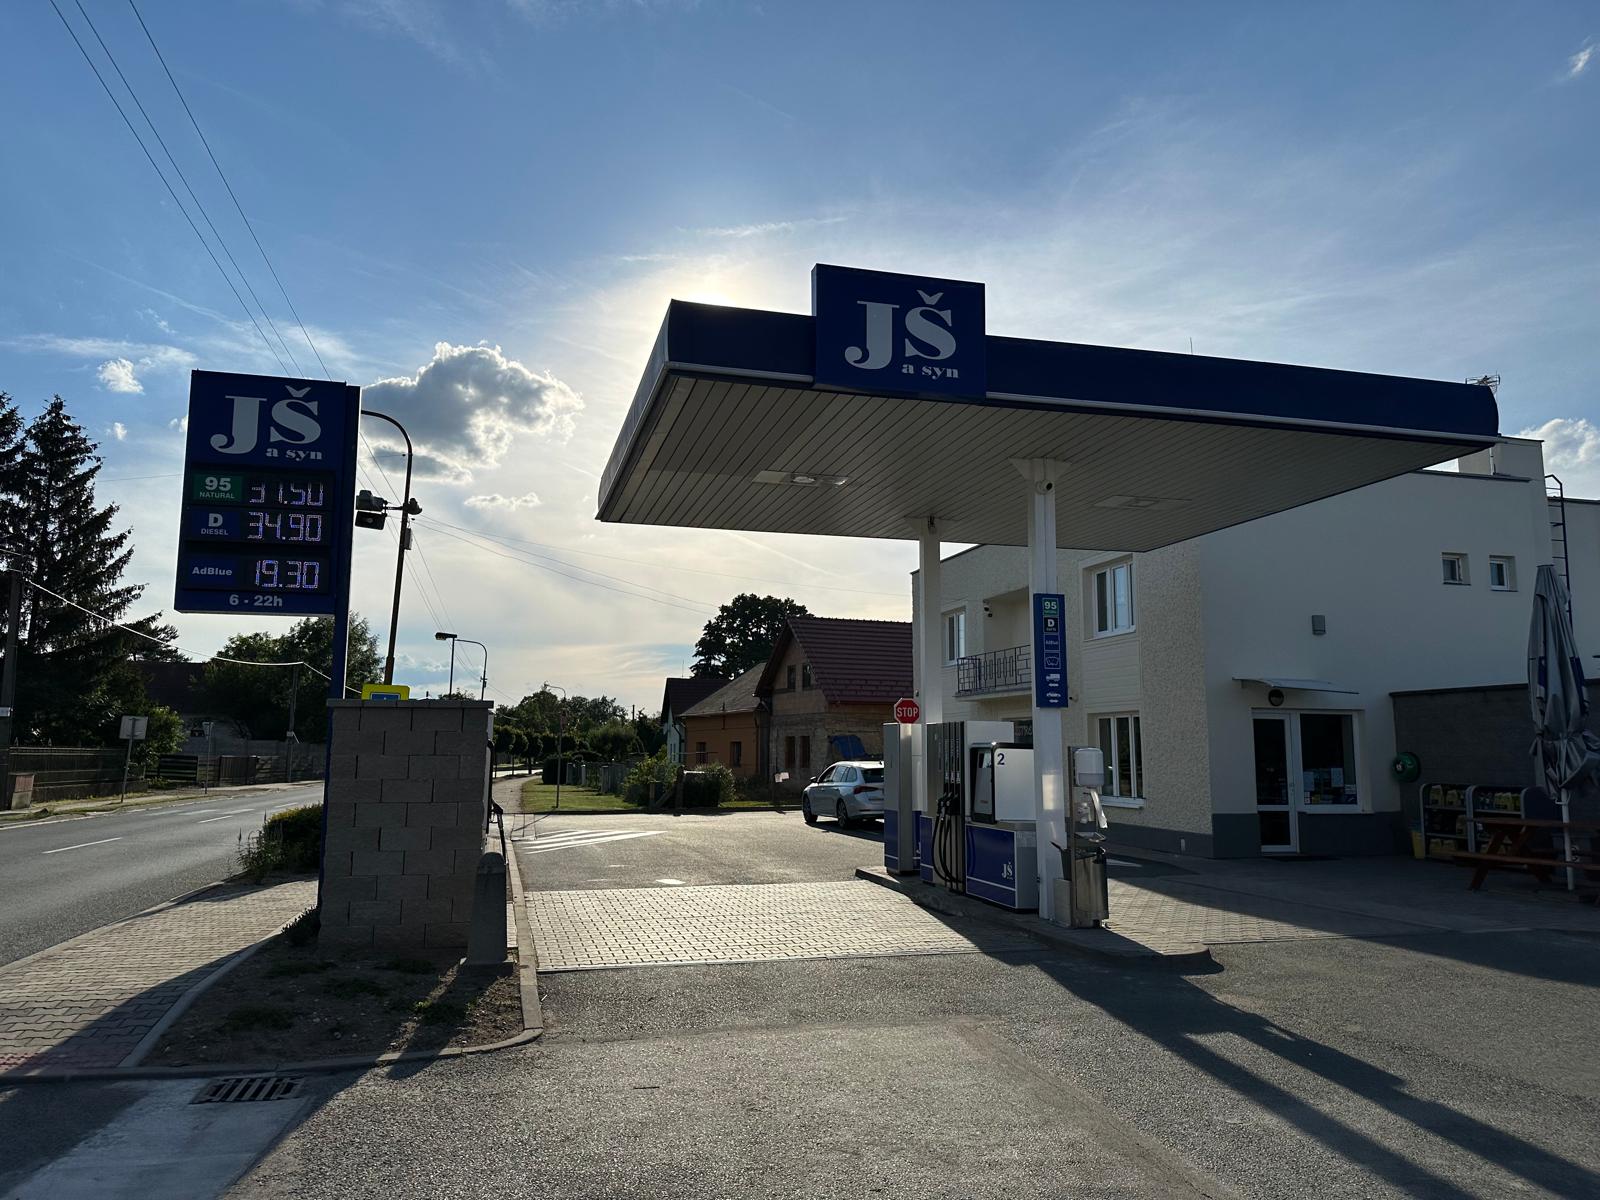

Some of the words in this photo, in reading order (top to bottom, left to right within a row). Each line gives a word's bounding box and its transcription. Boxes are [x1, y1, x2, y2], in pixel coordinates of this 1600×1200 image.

[845, 289, 957, 370] JŠ
[902, 363, 915, 375] a
[921, 365, 960, 380] syn
[210, 384, 322, 455] JŠ
[265, 447, 279, 458] a
[285, 449, 323, 462] syn
[205, 476, 232, 492] 95
[200, 491, 236, 500] NATURAL
[208, 512, 224, 528] D
[247, 511, 323, 542] 34.90
[200, 528, 229, 536] DIESEL
[192, 566, 233, 576] AdBlue
[255, 559, 320, 589] 19.30
[229, 594, 240, 606] 6
[253, 594, 283, 607] 22h
[1044, 601, 1057, 610] 95
[1047, 618, 1055, 627] D
[896, 707, 919, 718] STOP
[997, 752, 1005, 766] 2
